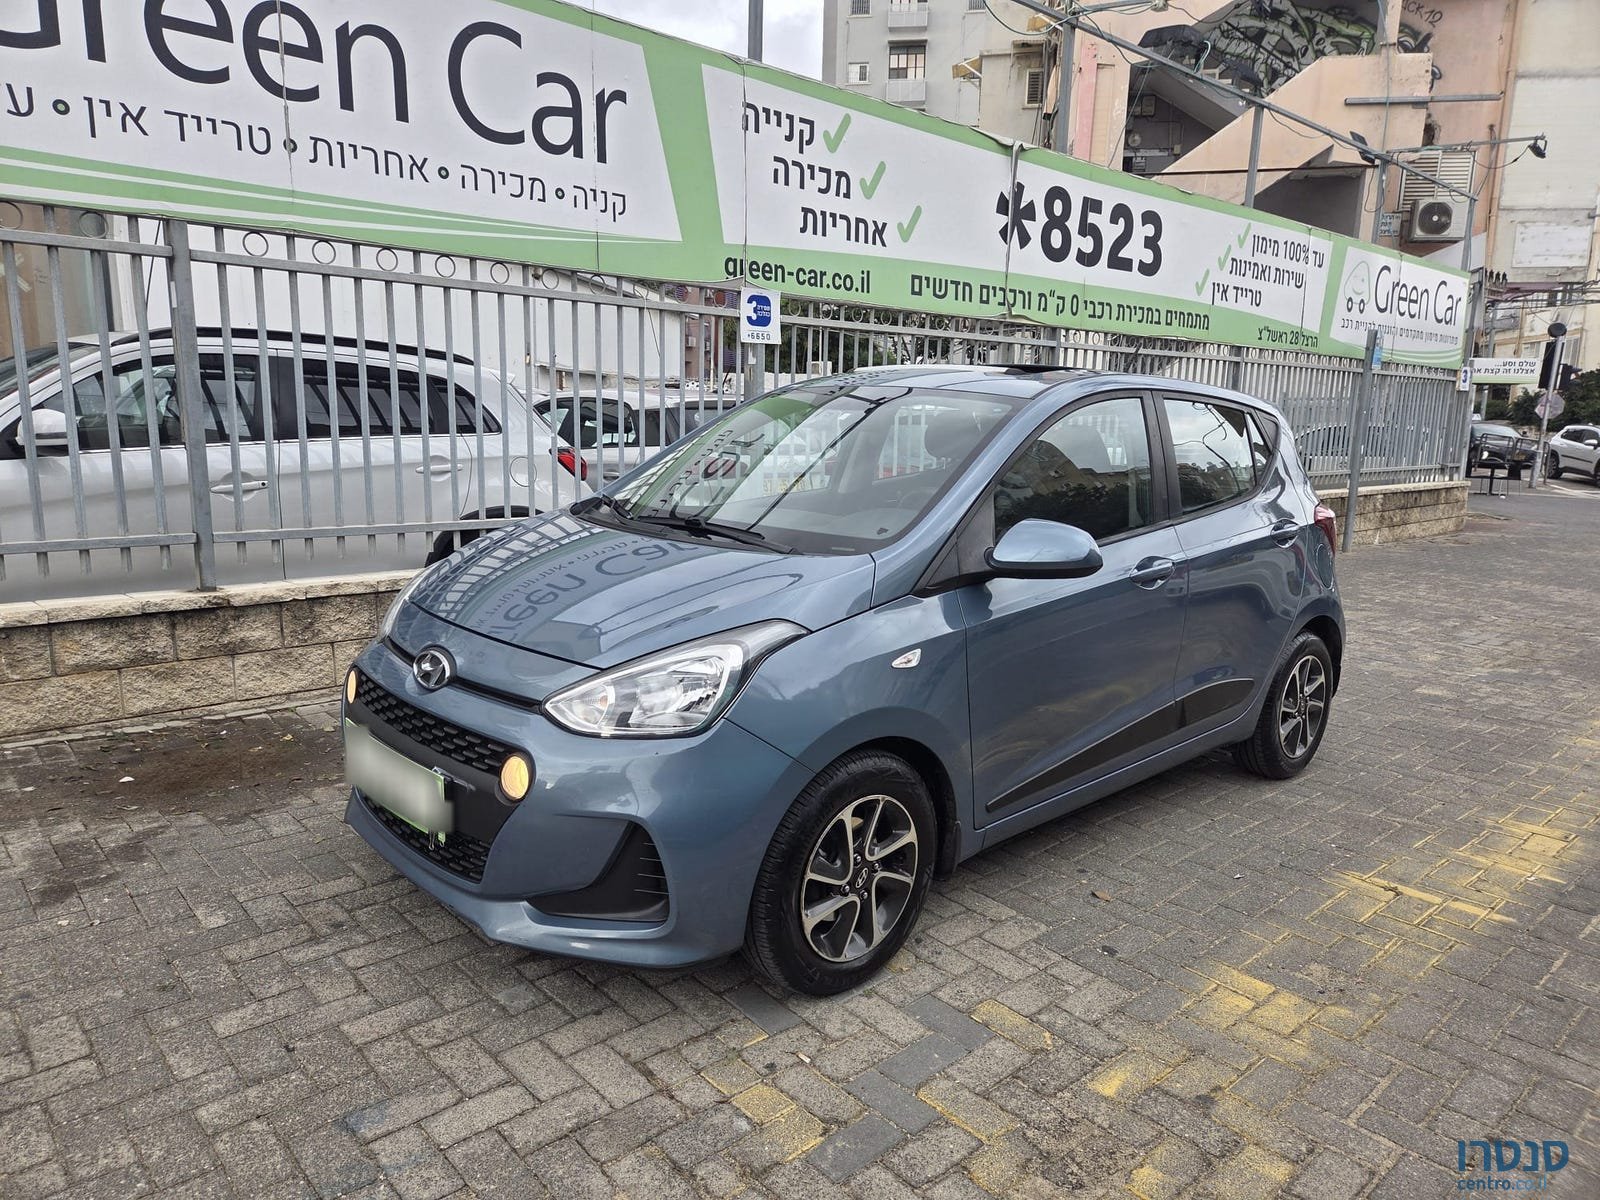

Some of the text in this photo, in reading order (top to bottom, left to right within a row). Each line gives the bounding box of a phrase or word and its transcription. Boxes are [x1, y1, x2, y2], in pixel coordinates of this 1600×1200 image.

[448, 21, 626, 163] Car
[83, 96, 149, 138] אין
[164, 110, 271, 155] טרייד
[742, 101, 815, 154] קנייה
[309, 136, 429, 182] אחריות
[773, 156, 851, 199] מכירה
[461, 164, 546, 202] מכירה
[573, 185, 627, 222] קניה
[800, 207, 887, 247] אחריות
[1251, 234, 1325, 268] עד 100% מימון
[724, 256, 871, 294] green-car.co.il
[910, 274, 973, 303] חדשים
[1229, 257, 1304, 289] שירות ואמינות
[980, 283, 1032, 310] ורכבים
[1070, 294, 1079, 316] 0
[1083, 301, 1113, 322] רכבי
[1212, 282, 1262, 307] טרייד אין
[1375, 265, 1461, 326] Green Car
[1116, 304, 1162, 325] במכירת
[1165, 309, 1210, 331] מתמחים
[1289, 331, 1299, 346] 28
